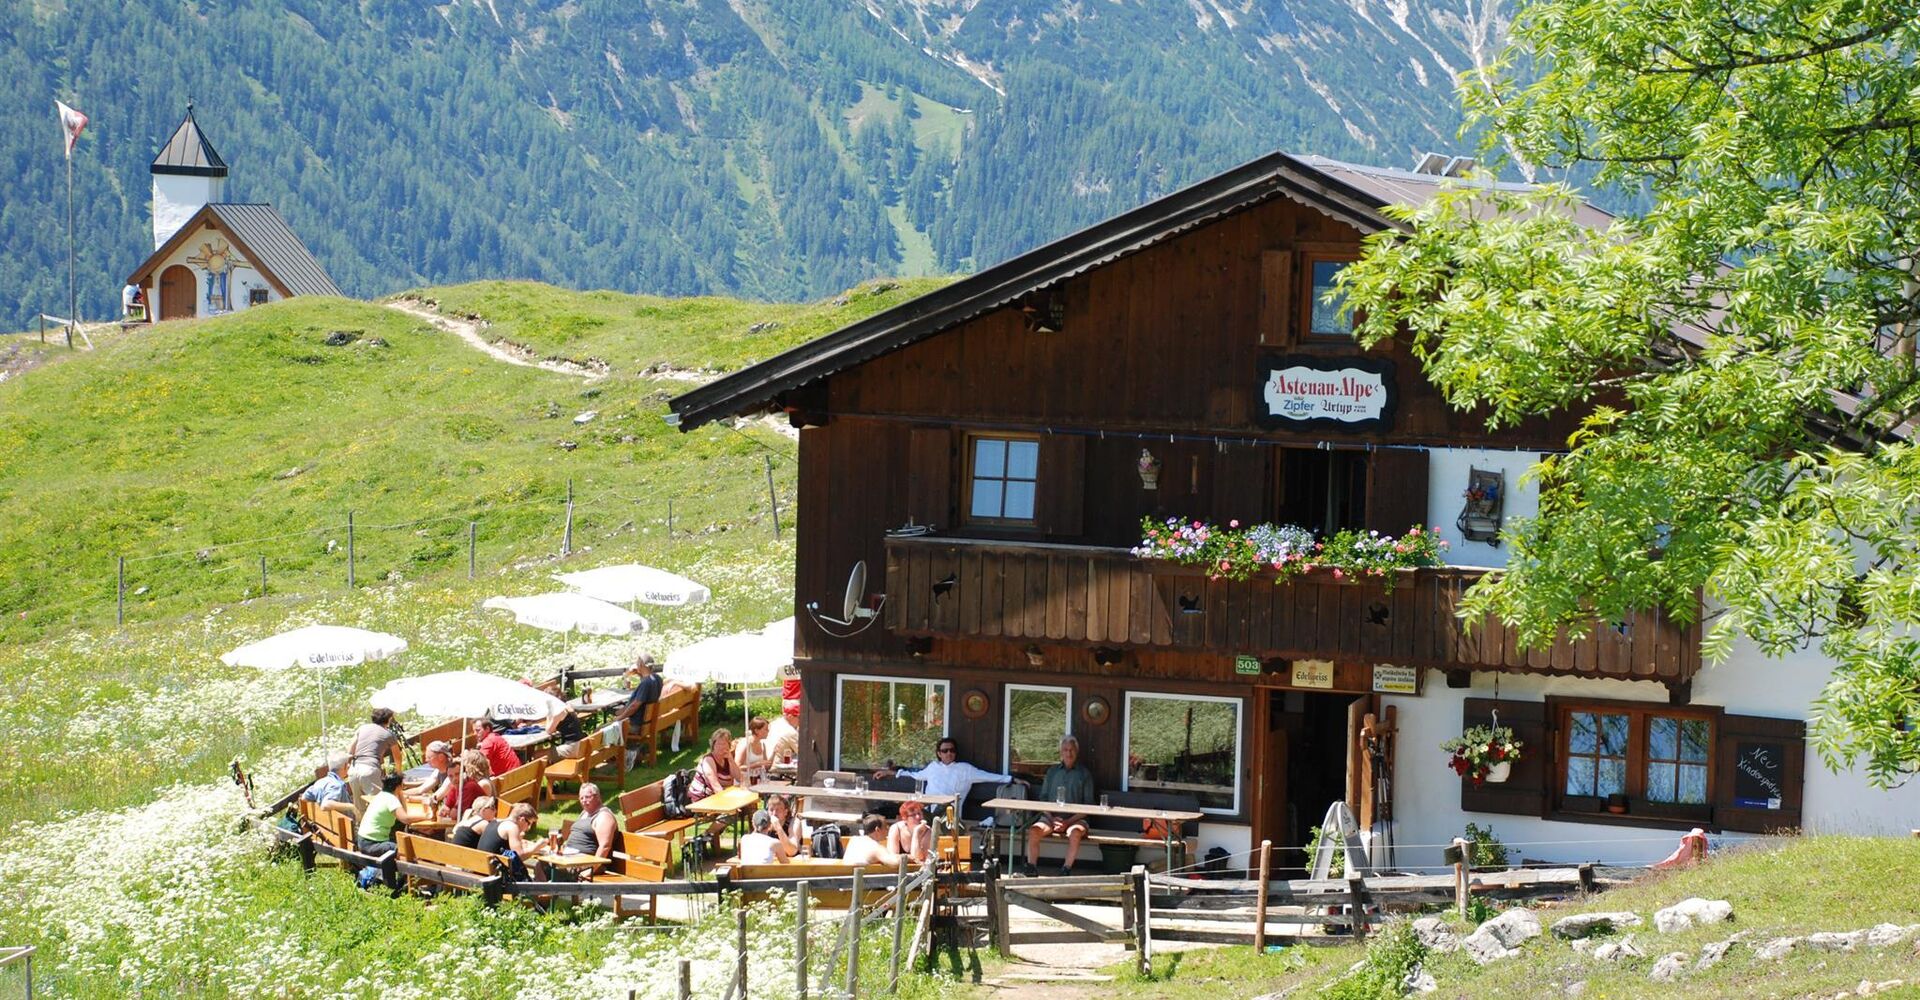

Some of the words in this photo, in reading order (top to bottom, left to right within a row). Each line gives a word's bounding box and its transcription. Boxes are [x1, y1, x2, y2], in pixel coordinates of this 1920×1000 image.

[1276, 374, 1373, 402] Astenau-Alpe
[1283, 399, 1315, 412] Zipfer
[1321, 399, 1353, 415] Urtyp
[645, 591, 681, 602] Edelweiss
[309, 651, 354, 663] Edelweiss
[1238, 660, 1259, 669] 503
[1296, 670, 1328, 682] Edelweiss
[497, 703, 537, 715] Edelweiss
[1749, 747, 1777, 769] Neu
